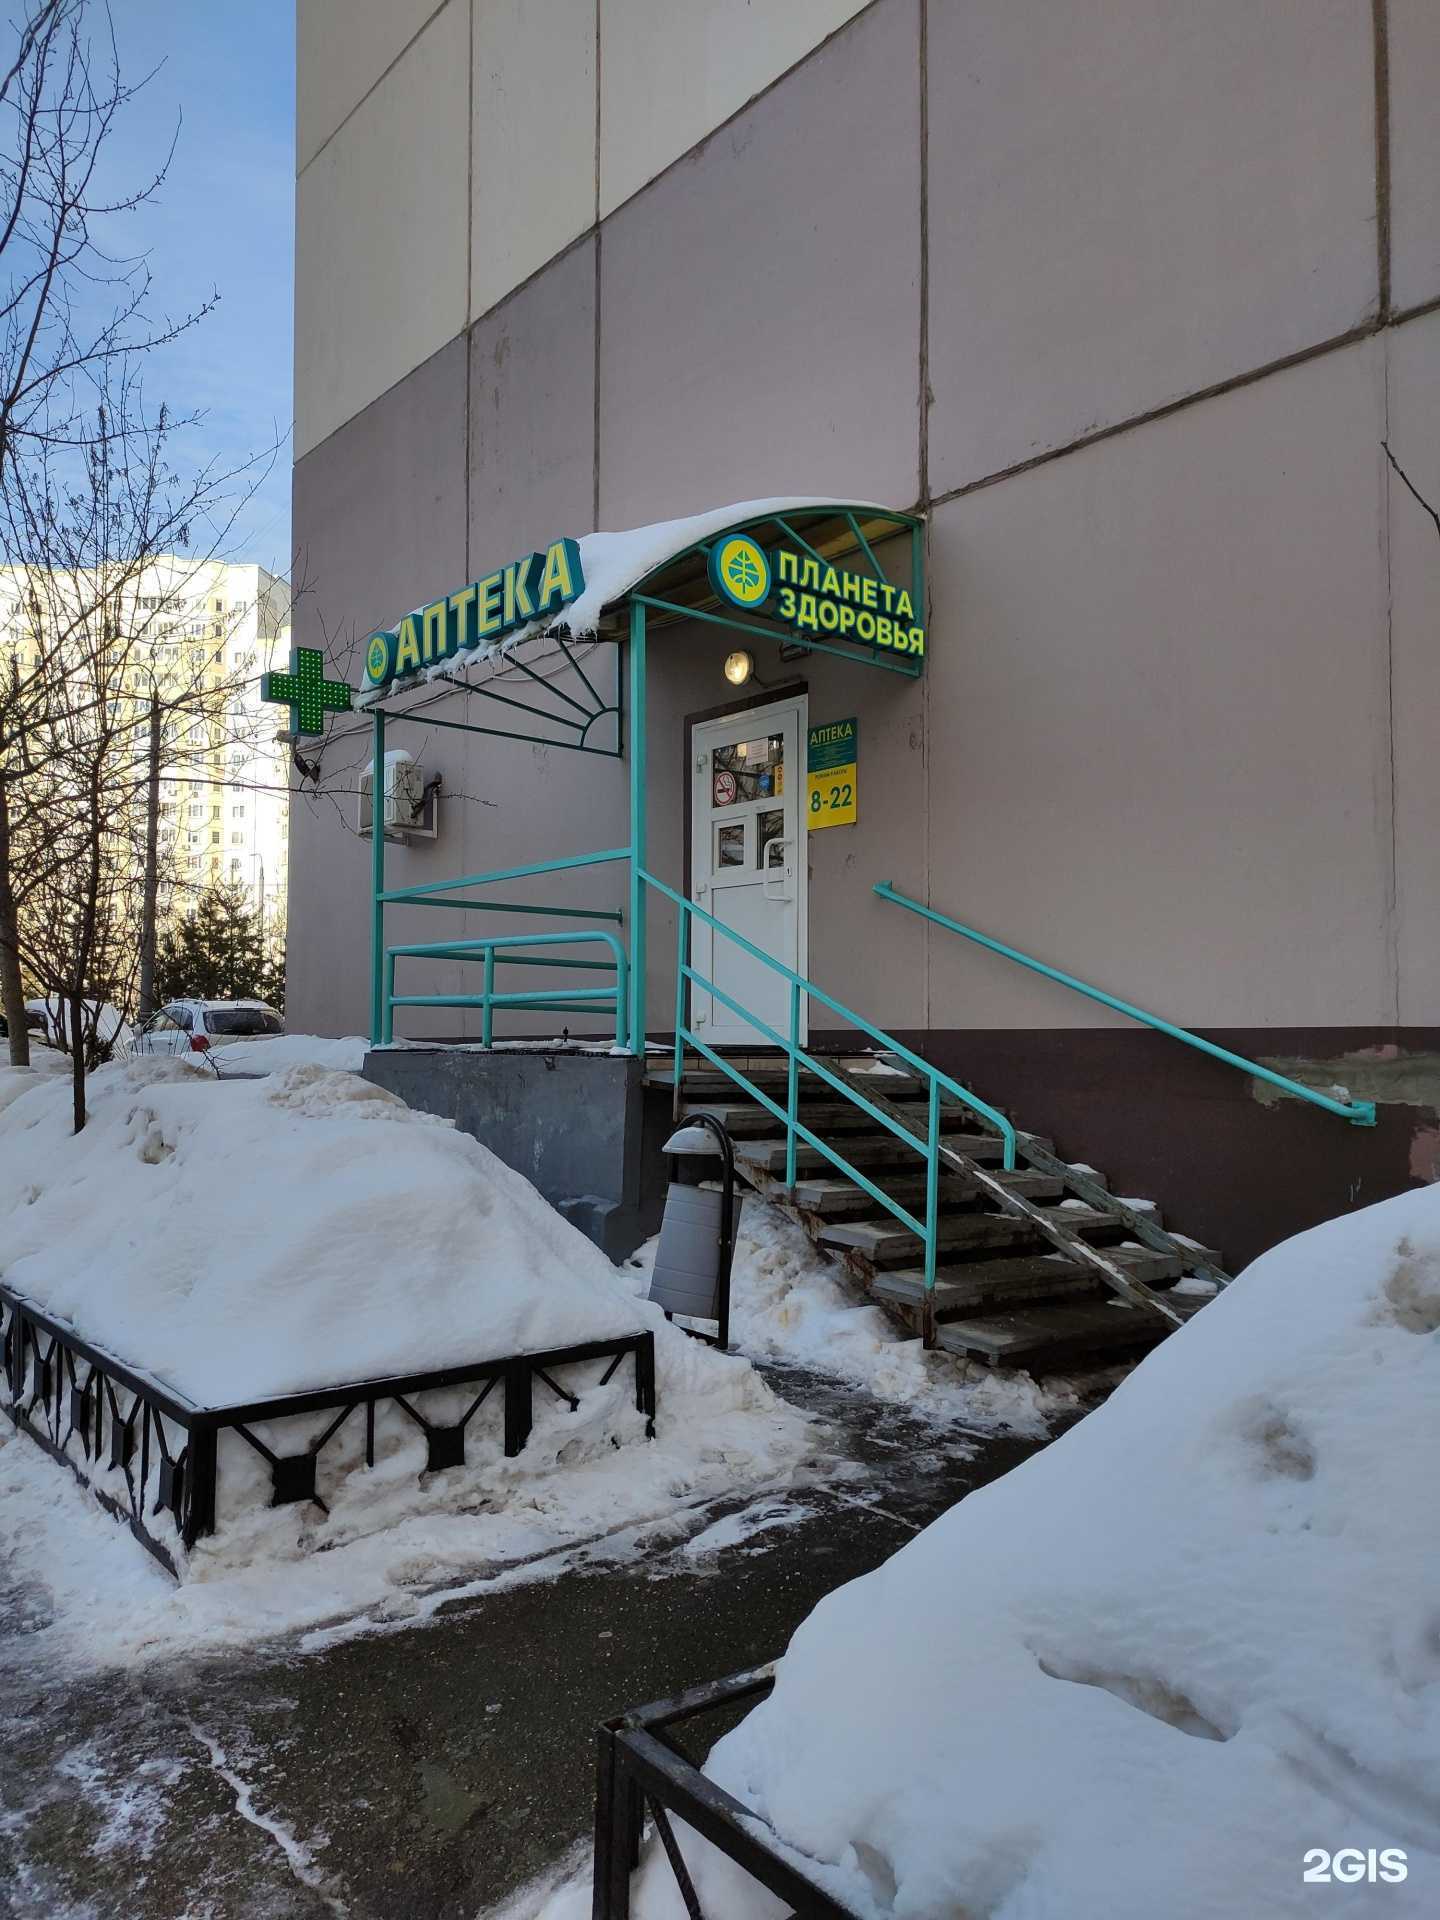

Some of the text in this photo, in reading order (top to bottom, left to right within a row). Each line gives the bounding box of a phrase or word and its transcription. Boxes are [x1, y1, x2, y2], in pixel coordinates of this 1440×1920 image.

[395, 542, 575, 675] АПТЕКА
[779, 551, 914, 619] ПЛАНЕТА
[779, 587, 924, 656] ЗДОРОВЬЯ
[810, 723, 853, 745] АПТЕКА
[811, 784, 853, 813] 8-22
